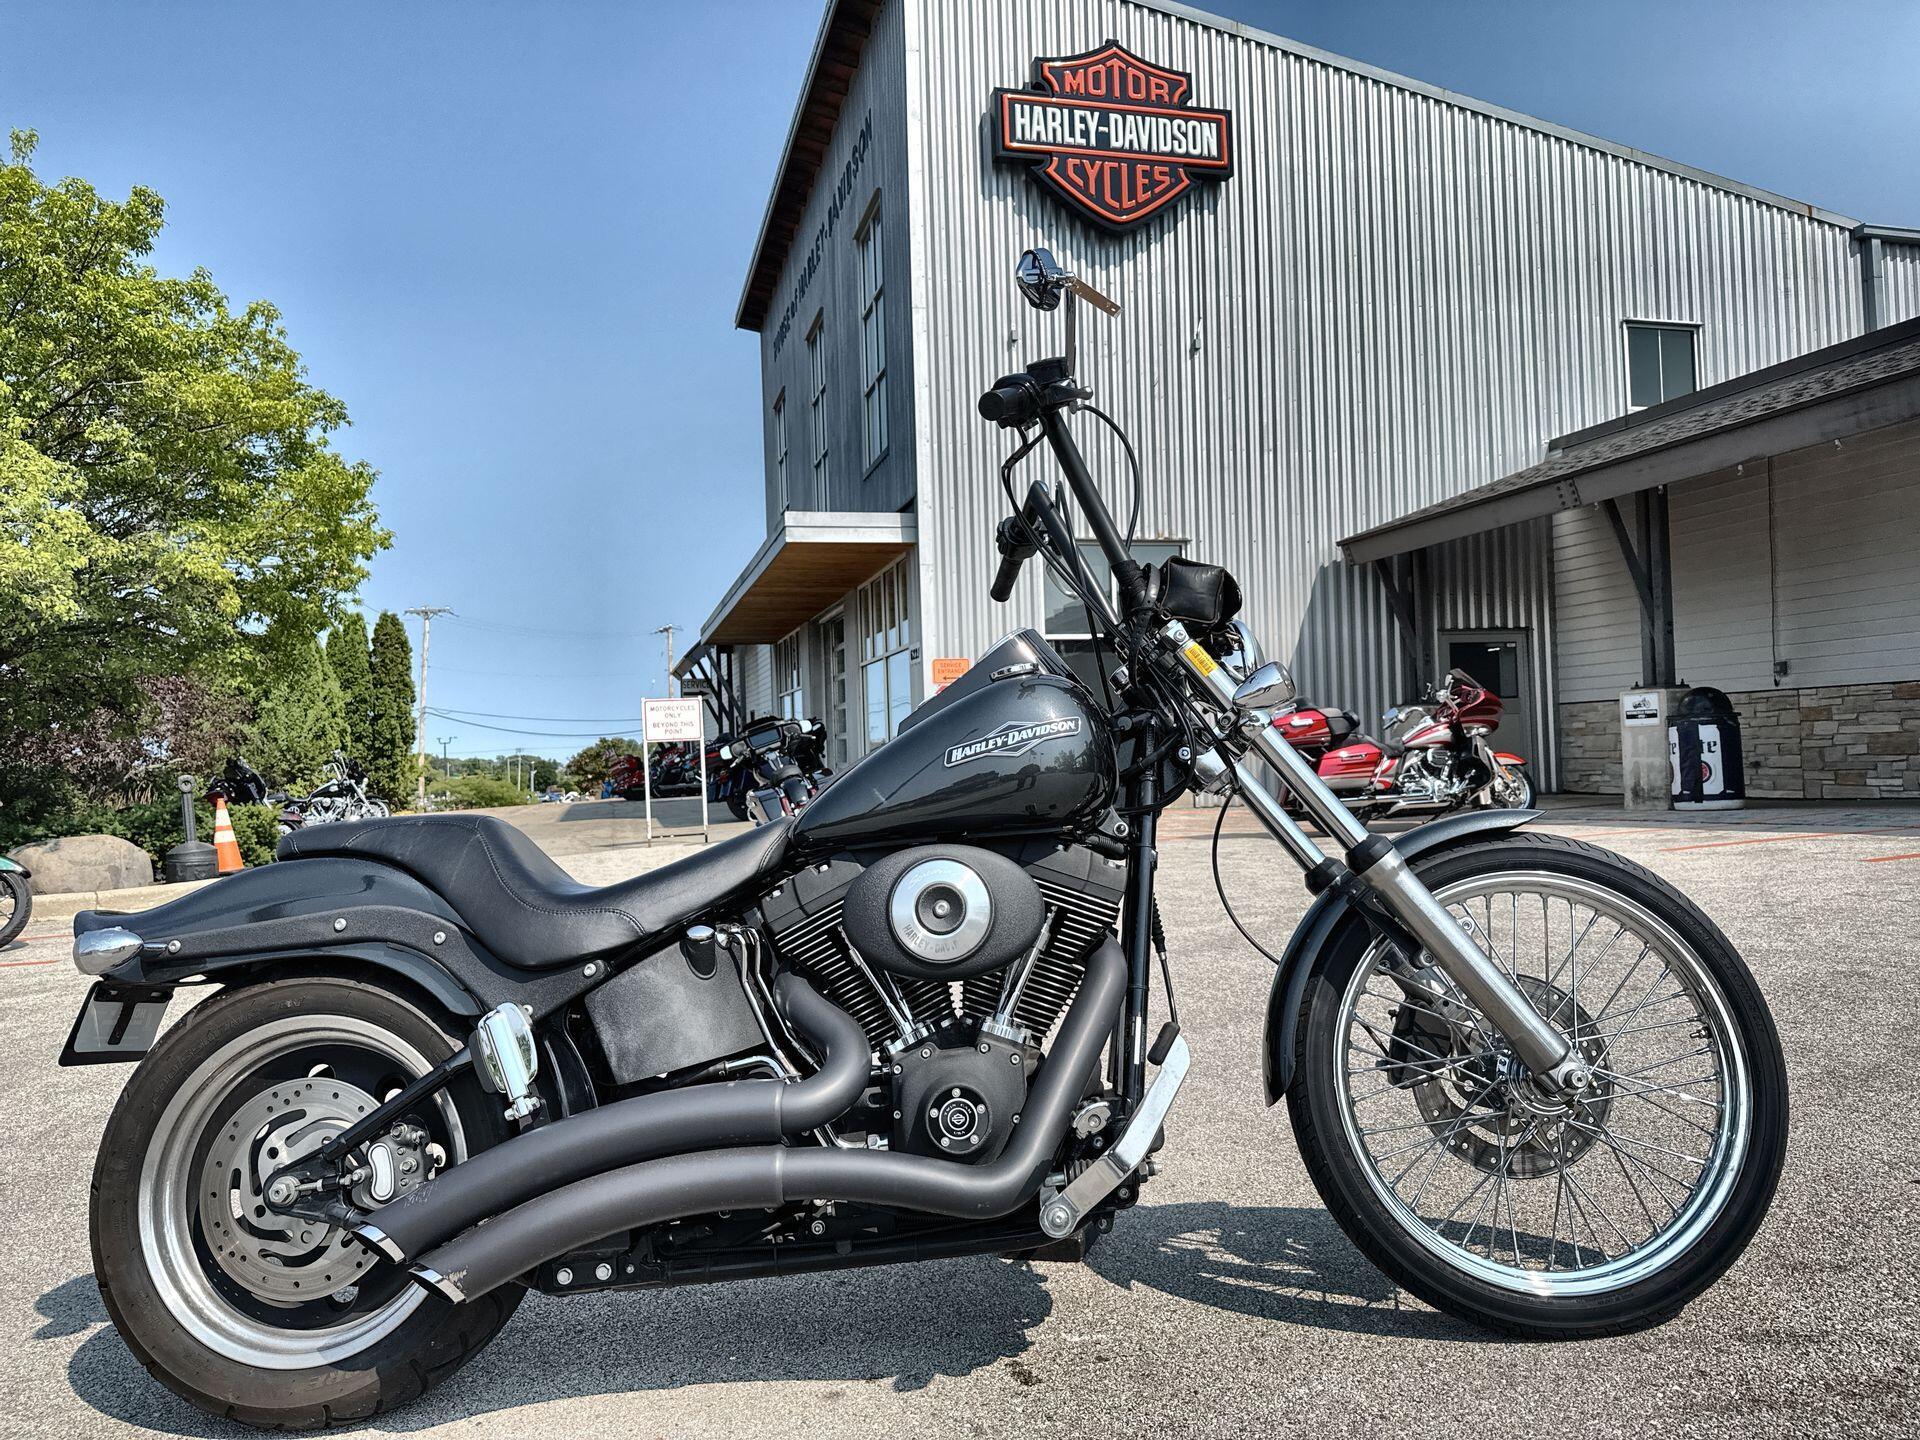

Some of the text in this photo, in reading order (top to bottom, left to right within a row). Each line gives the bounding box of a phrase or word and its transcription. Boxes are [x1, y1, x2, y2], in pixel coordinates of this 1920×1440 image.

[1064, 58, 1169, 104] MOTOR
[1014, 103, 1218, 158] HARLEY-DAVIDSON
[1066, 157, 1170, 209] CYCLES
[951, 720, 1076, 762] HARLEY-DAVIDSON
